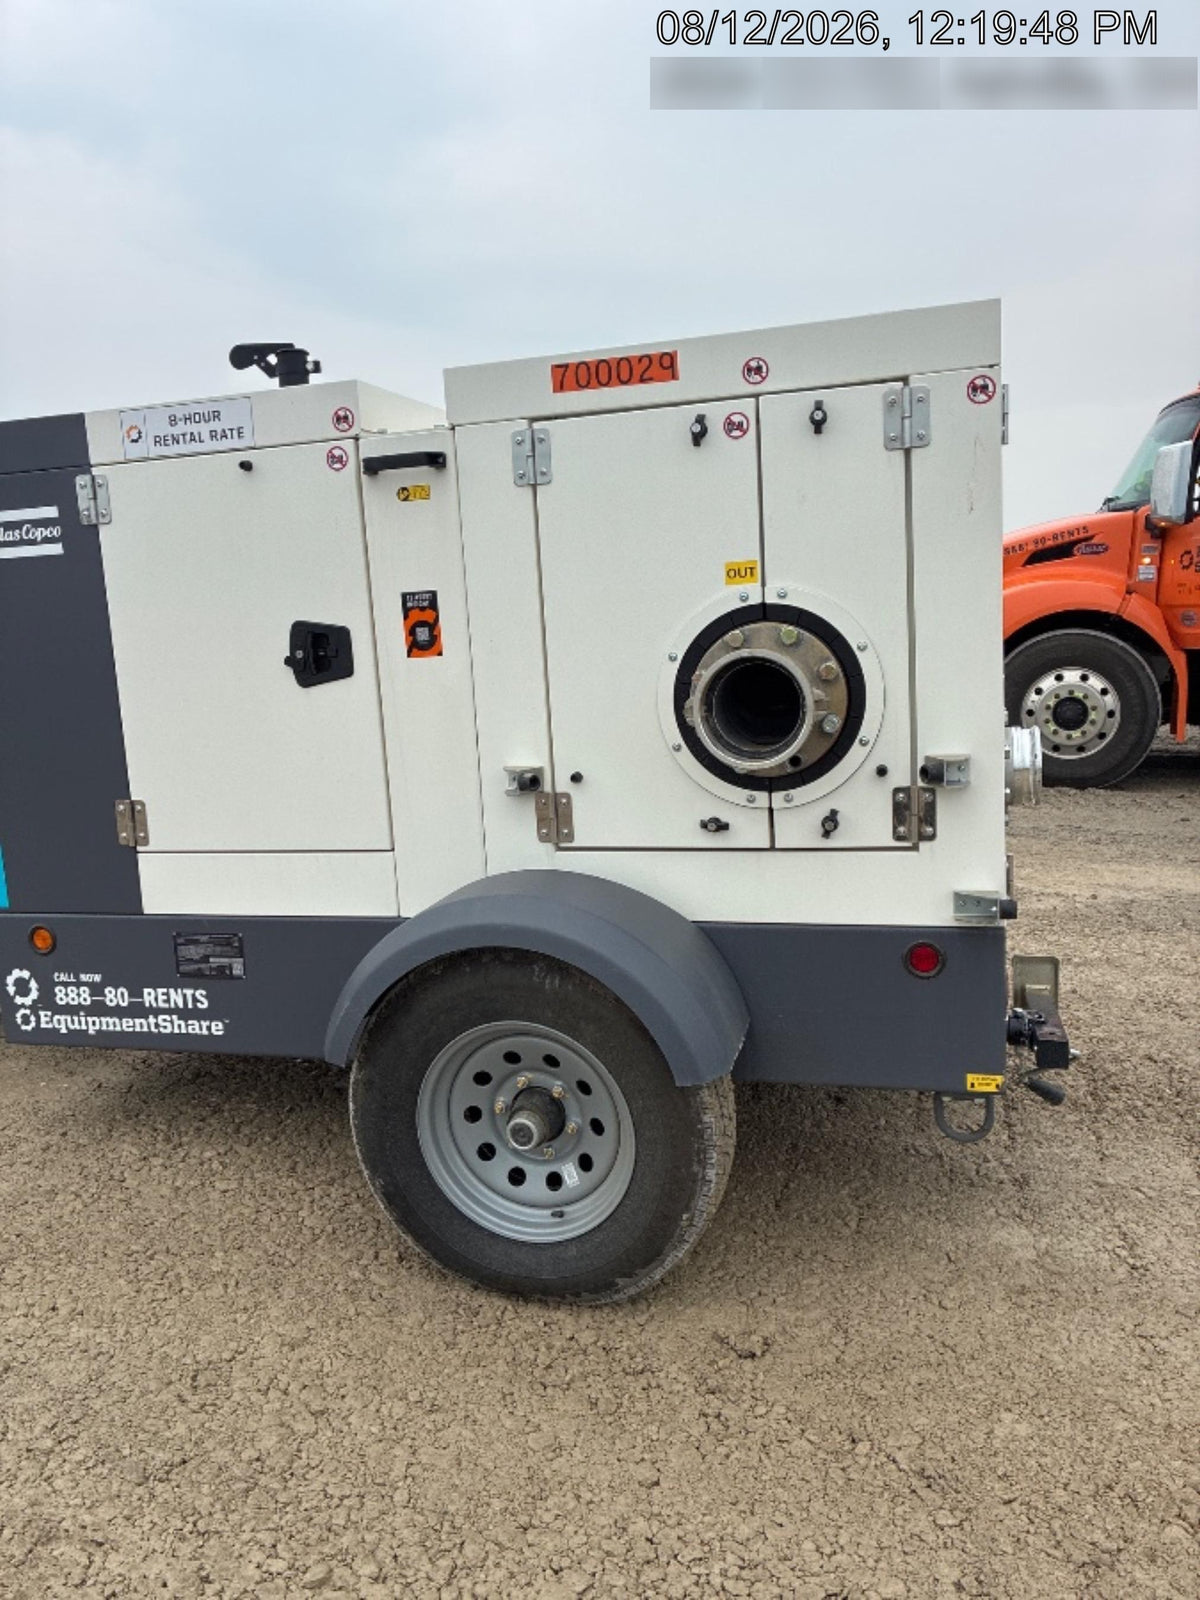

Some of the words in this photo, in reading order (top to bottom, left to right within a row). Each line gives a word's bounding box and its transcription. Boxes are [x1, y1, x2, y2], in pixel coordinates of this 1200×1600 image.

[554, 351, 676, 390] 700029
[168, 410, 222, 428] 8-HOUR
[153, 431, 205, 448] RENTAL
[209, 426, 246, 442] RATE
[22, 523, 61, 543] Copco
[726, 566, 757, 579] OUT
[53, 971, 77, 983] CALL
[79, 972, 102, 983] NOW
[38, 1010, 225, 1036] EquipmentShare
